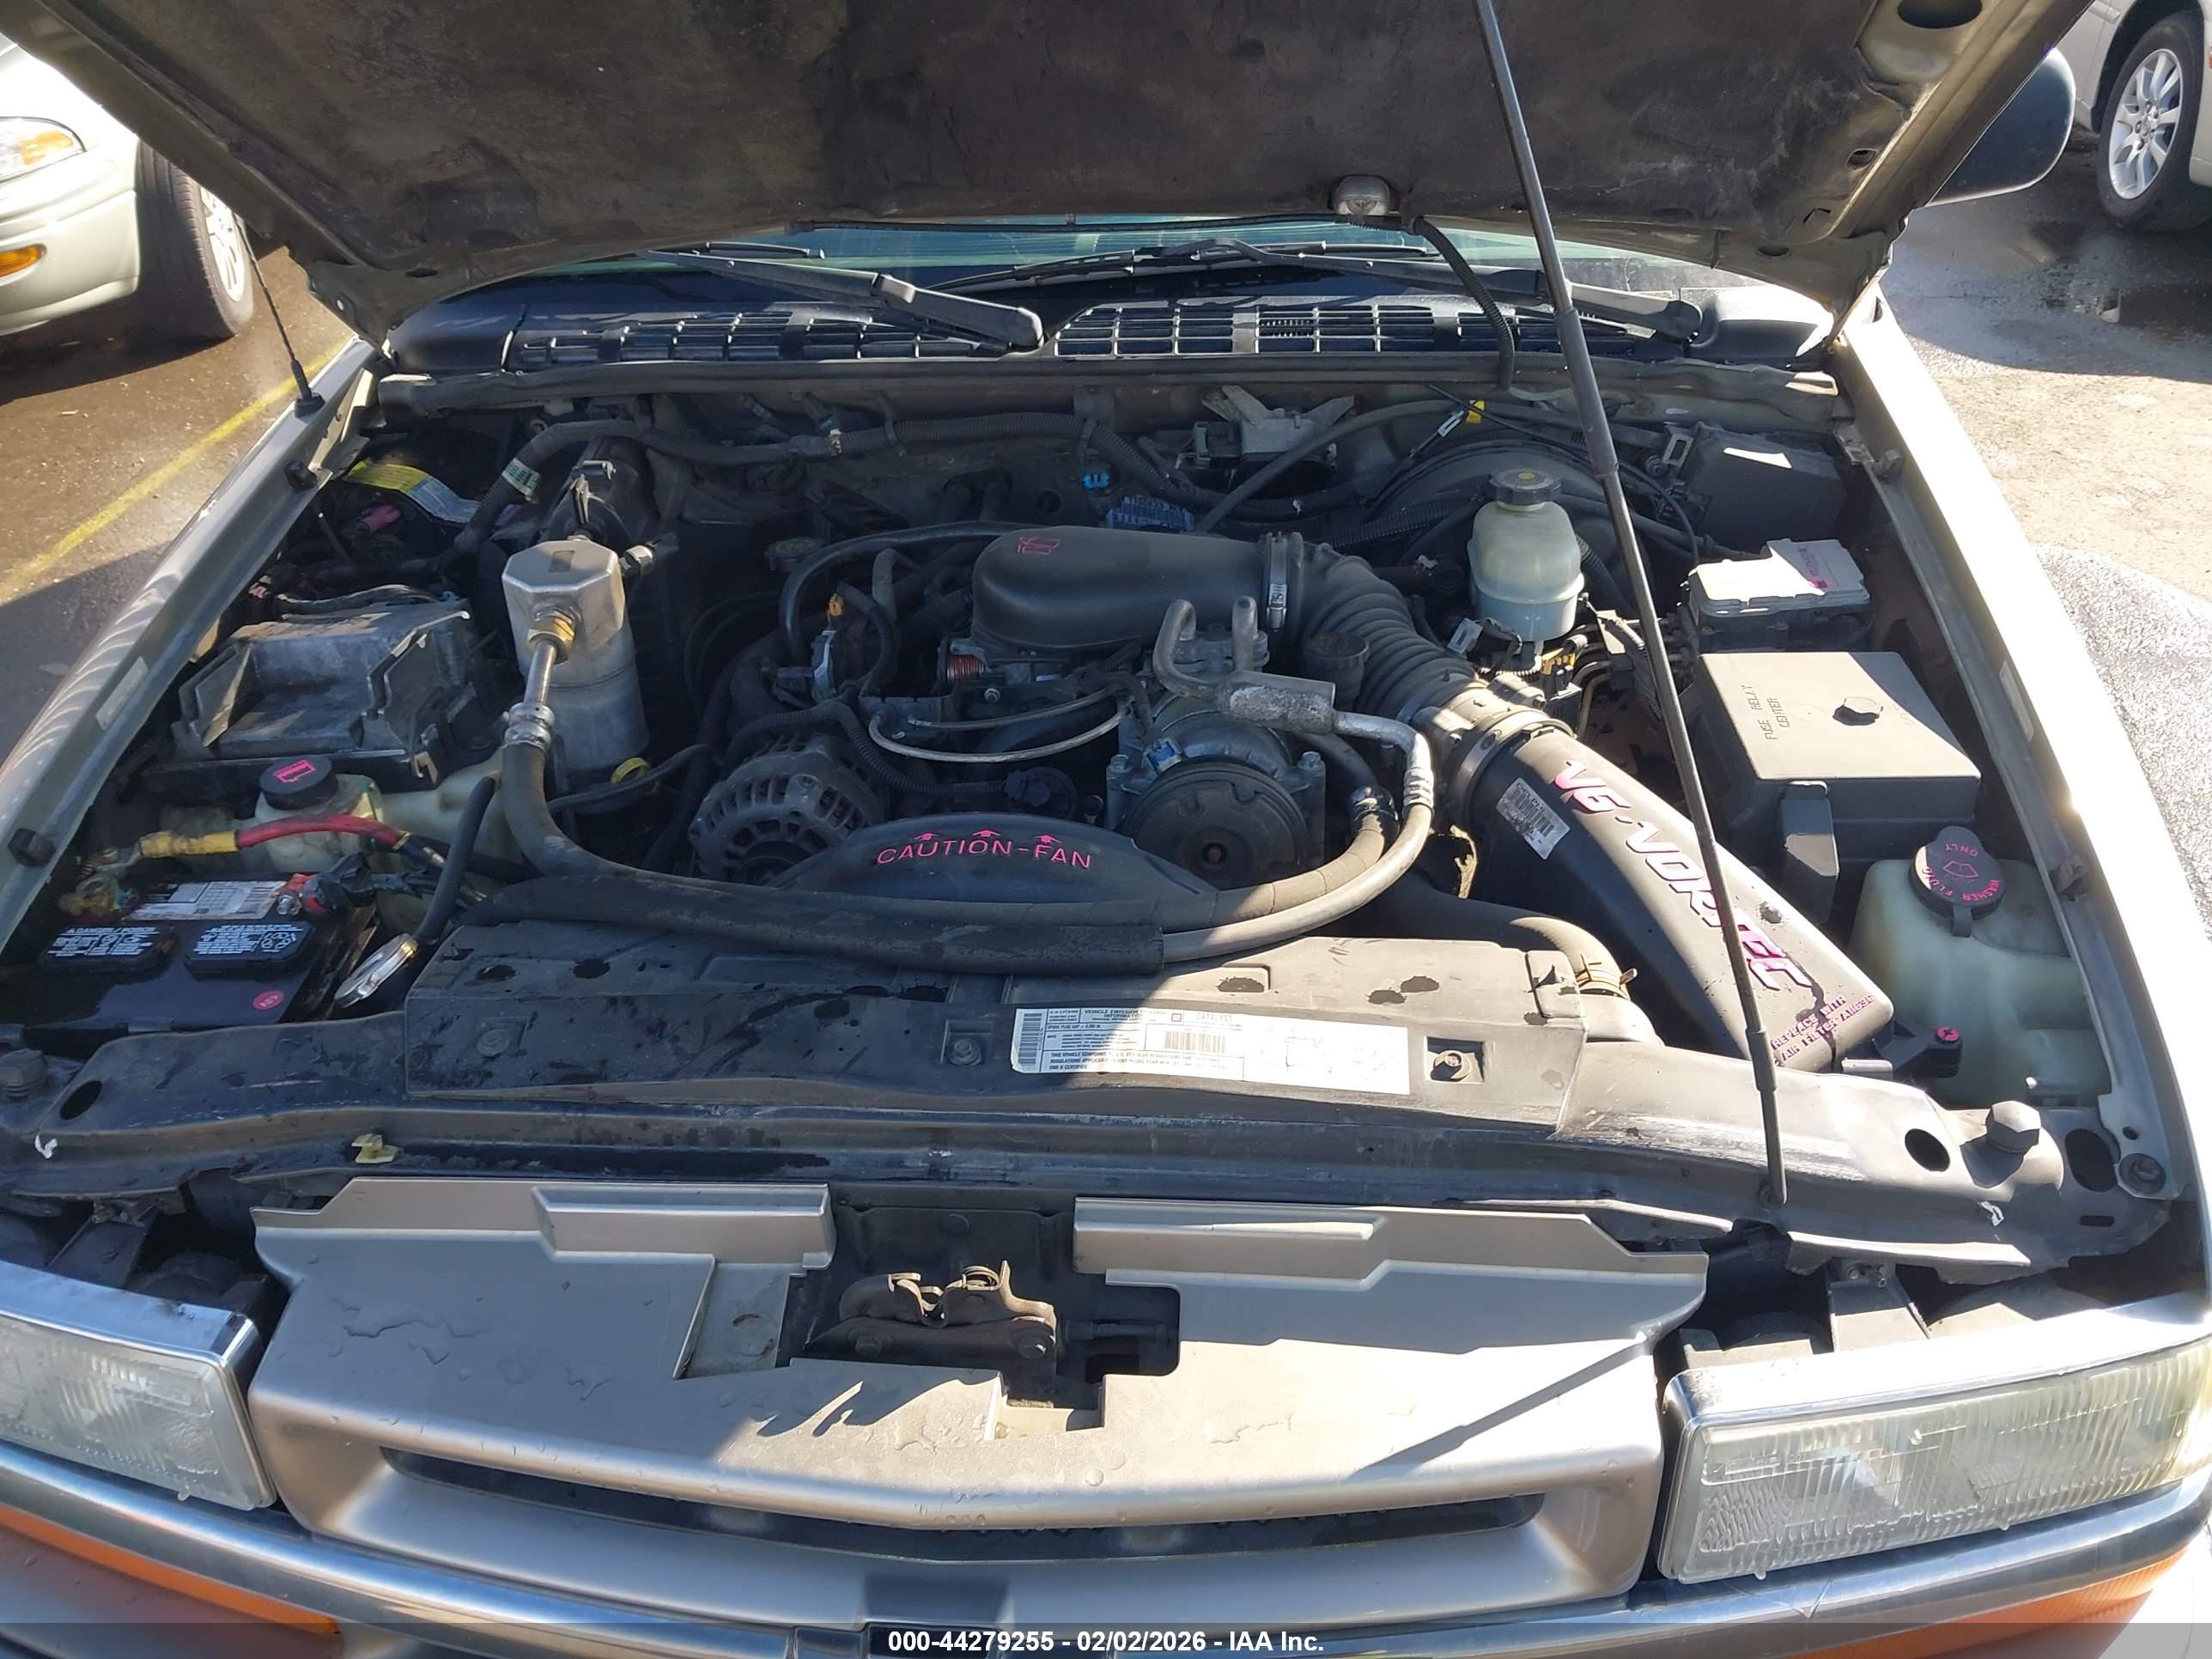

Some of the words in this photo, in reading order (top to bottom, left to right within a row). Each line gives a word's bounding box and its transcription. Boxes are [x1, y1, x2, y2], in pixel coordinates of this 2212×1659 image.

[1741, 684, 1763, 710] RELAY
[1766, 697, 1790, 728] CENTER
[1757, 719, 1778, 740] FUSE
[1945, 843, 1979, 857] ONLY
[1923, 866, 1953, 896] FLUID
[1962, 879, 2001, 901] WASHER
[1771, 1013, 1820, 1049] REPLACE
[1820, 996, 1848, 1016] WITH
[1802, 1018, 1838, 1046] FILTER
